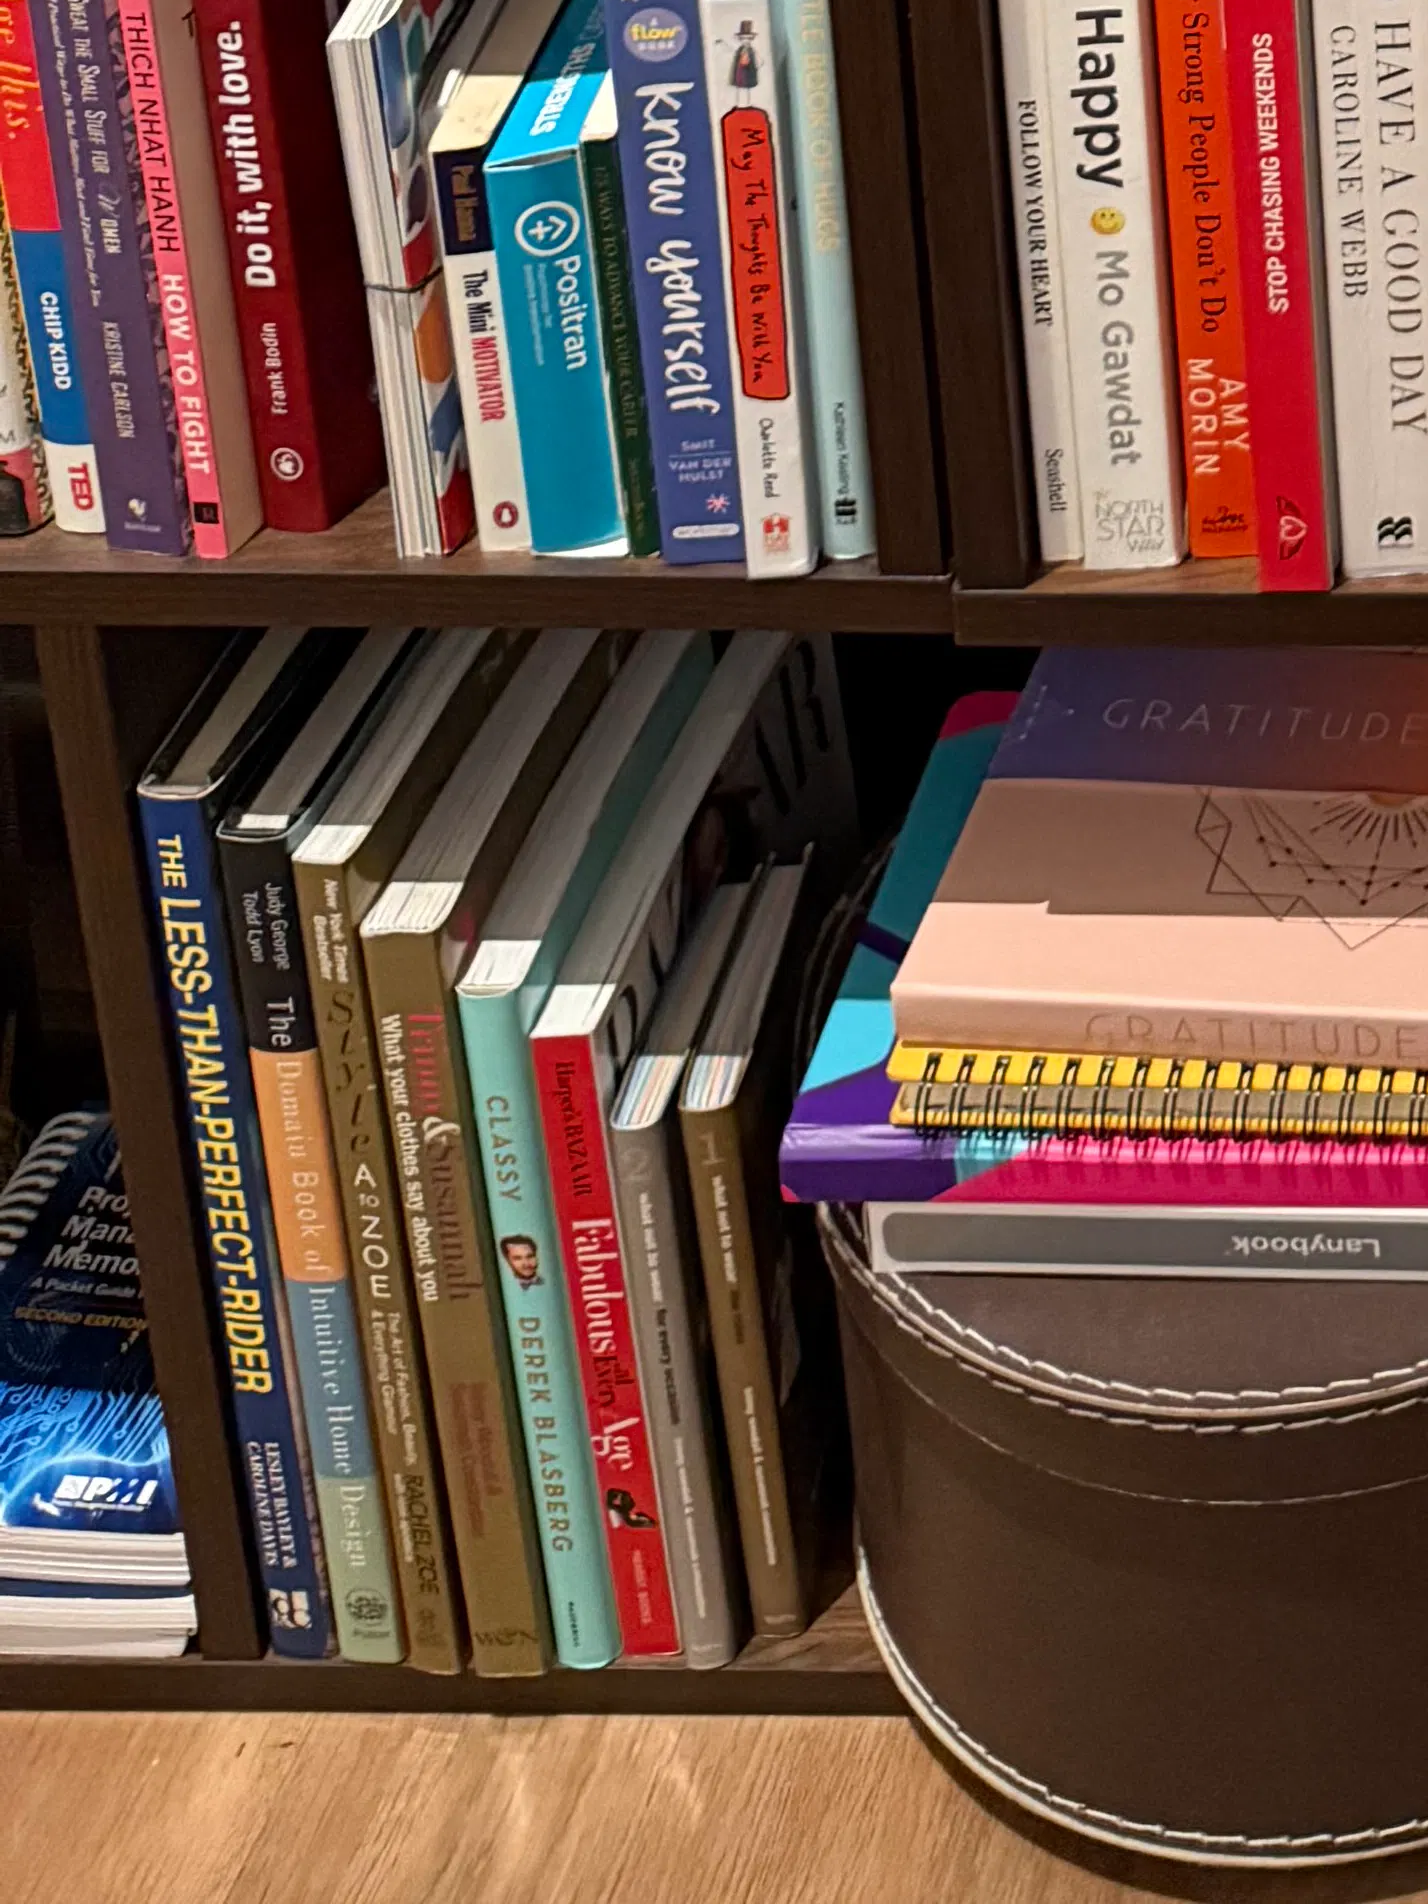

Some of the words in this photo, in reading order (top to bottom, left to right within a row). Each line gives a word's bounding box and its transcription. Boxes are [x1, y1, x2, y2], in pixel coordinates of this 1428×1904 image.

[216, 22, 253, 105] love.
[1173, 11, 1213, 104] Strong
[1251, 33, 1280, 150] WEEKENDS
[1072, 6, 1126, 187] Happy
[1329, 25, 1363, 192] CAROLINE
[227, 115, 264, 193] with
[636, 83, 694, 215] know
[1018, 99, 1043, 185] FOLLOW
[1178, 114, 1218, 202] People
[232, 200, 270, 238] it,
[1024, 193, 1047, 254] YOUR
[1259, 157, 1286, 246] CHASING
[241, 243, 276, 287] Do
[463, 270, 489, 298] The
[1096, 250, 1132, 306] Mo
[1190, 212, 1223, 288] Don't
[1265, 253, 1290, 312] STOP
[1338, 208, 1369, 297] WEBB
[38, 292, 64, 335] CHIP
[160, 275, 191, 342] HOW
[467, 303, 494, 333] Mini
[553, 255, 592, 370] Positran
[646, 240, 720, 414] yourself
[1028, 260, 1051, 325] HEART
[1195, 298, 1225, 333] Do
[43, 342, 71, 389] KIDD
[169, 350, 197, 384] TO
[471, 337, 506, 421] MOTIVATOR
[1101, 320, 1144, 466] Gawdat
[174, 396, 208, 473] FIGHT
[1189, 359, 1220, 474] MORIN
[1218, 378, 1248, 449] AMY
[68, 463, 95, 512] TED
[155, 835, 190, 885] THE
[268, 998, 295, 1047] The
[1087, 1010, 1418, 1060] GRATITUDE
[163, 895, 274, 1391] LESS-THAN-PERFECT-RIDER
[275, 1063, 312, 1158] Domain
[487, 1095, 522, 1202] CLASSY
[289, 1171, 321, 1240] Book
[304, 1248, 329, 1274] of
[1233, 1231, 1380, 1260] Lanybook
[305, 1288, 346, 1395] Intuitive
[518, 1318, 557, 1408] DEREK
[325, 1405, 357, 1476] Home
[531, 1417, 575, 1551] BLASBERG
[335, 1486, 372, 1568] Design
